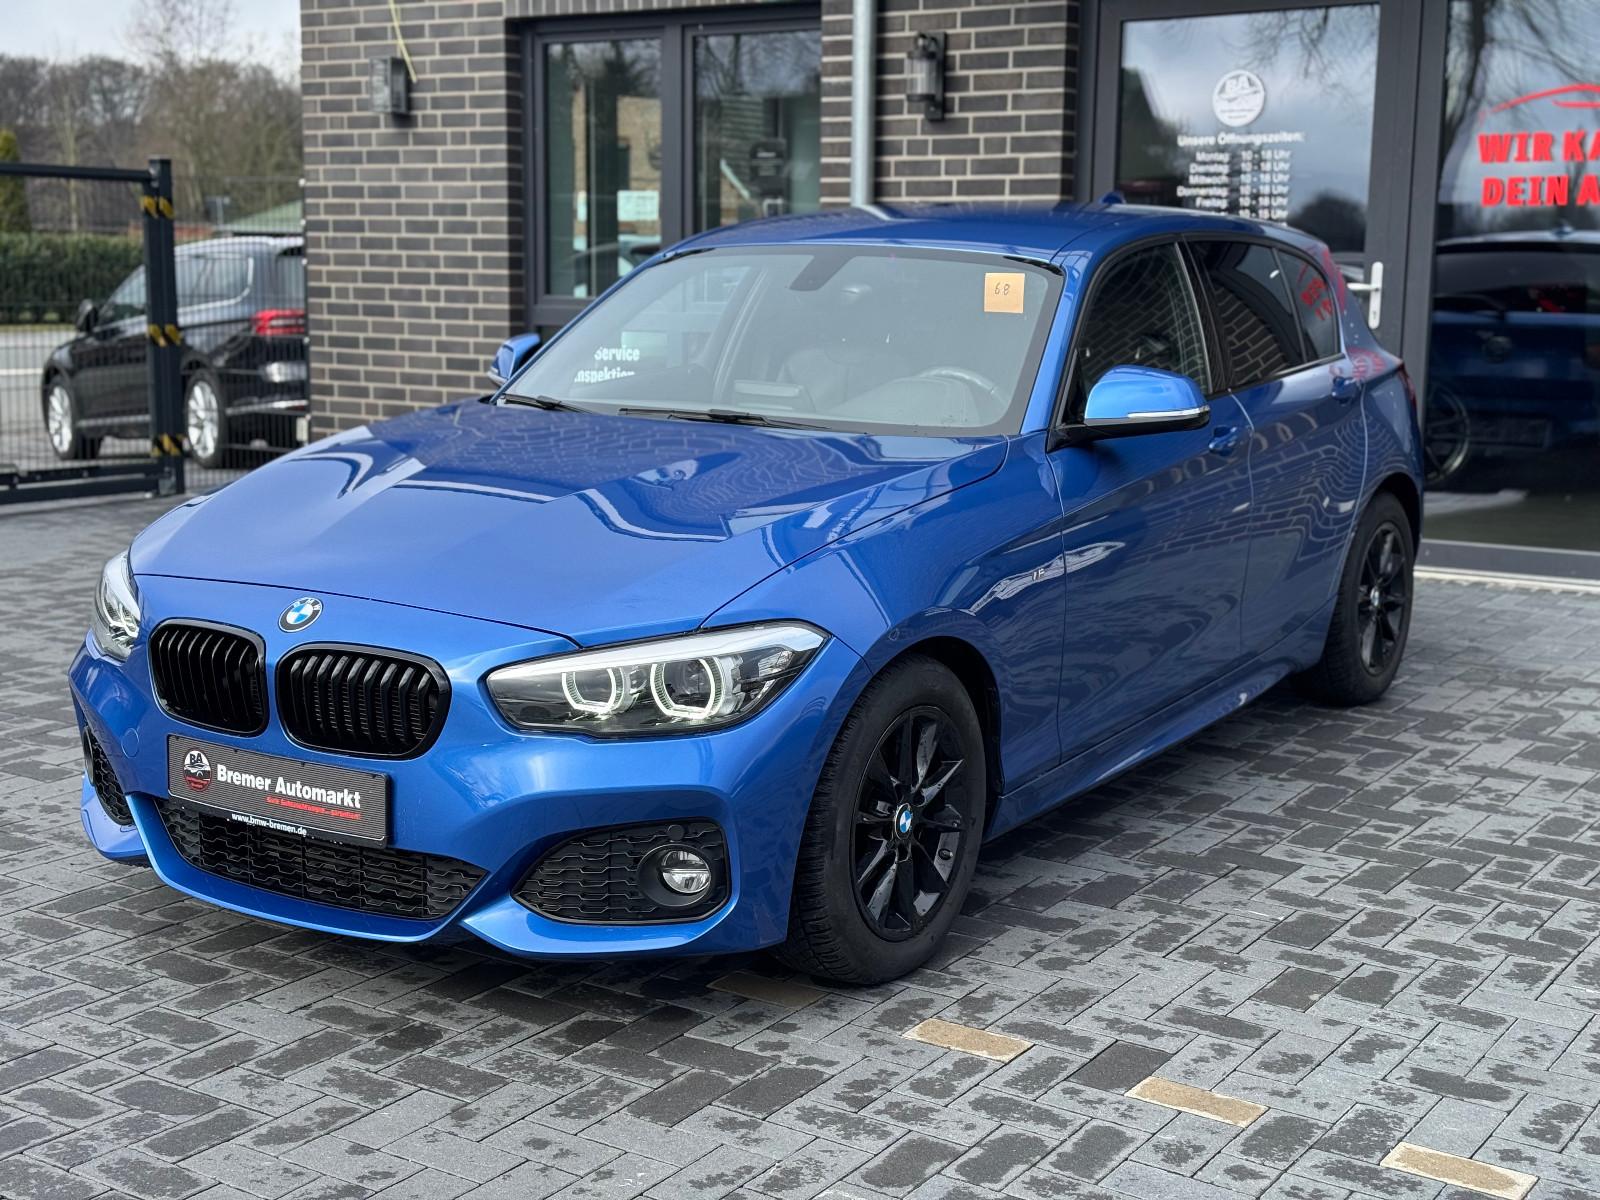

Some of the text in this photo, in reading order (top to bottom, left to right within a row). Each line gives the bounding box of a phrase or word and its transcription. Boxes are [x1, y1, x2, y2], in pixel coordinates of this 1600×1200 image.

[1477, 132, 1554, 164] WIR
[1481, 175, 1569, 208] DEIN
[594, 344, 640, 362] Service
[189, 752, 203, 765] BA
[217, 764, 272, 791] Bremer
[275, 776, 361, 809] Automarkt
[231, 813, 307, 835] www.bmw-bremen.de
